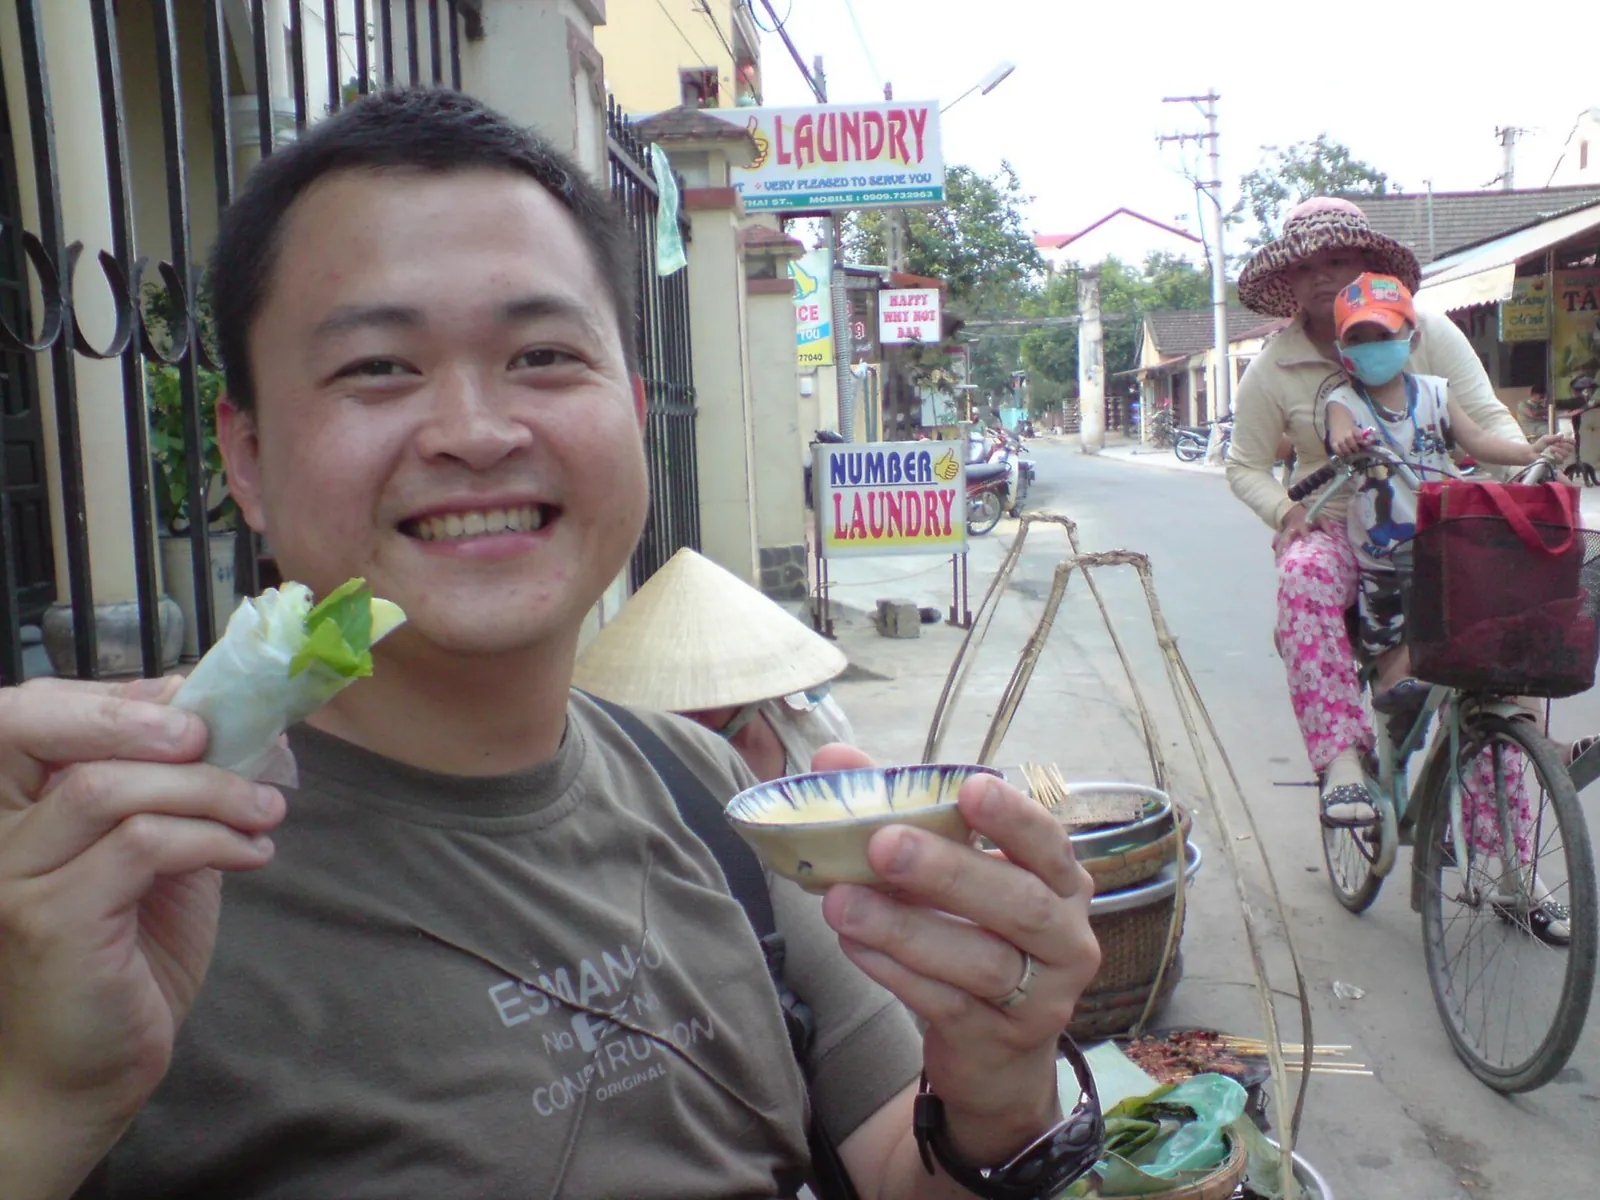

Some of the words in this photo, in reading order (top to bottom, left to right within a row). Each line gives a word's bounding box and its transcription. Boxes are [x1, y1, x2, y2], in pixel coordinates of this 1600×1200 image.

[774, 108, 928, 170] LAUNDRY
[763, 179, 795, 192] VERY
[797, 177, 850, 190] PLEASED
[851, 176, 867, 188] TO
[868, 174, 906, 186] SERVE
[908, 172, 932, 185] YOU
[808, 194, 853, 204] MOBILE
[889, 294, 928, 307] HAPPY
[882, 311, 909, 323] WHY
[912, 310, 936, 322] NOT
[896, 327, 922, 339] BAR
[830, 450, 932, 485] NUMBER
[832, 489, 956, 540] LAUNDRY
[595, 1062, 668, 1102] ORIGINAL
